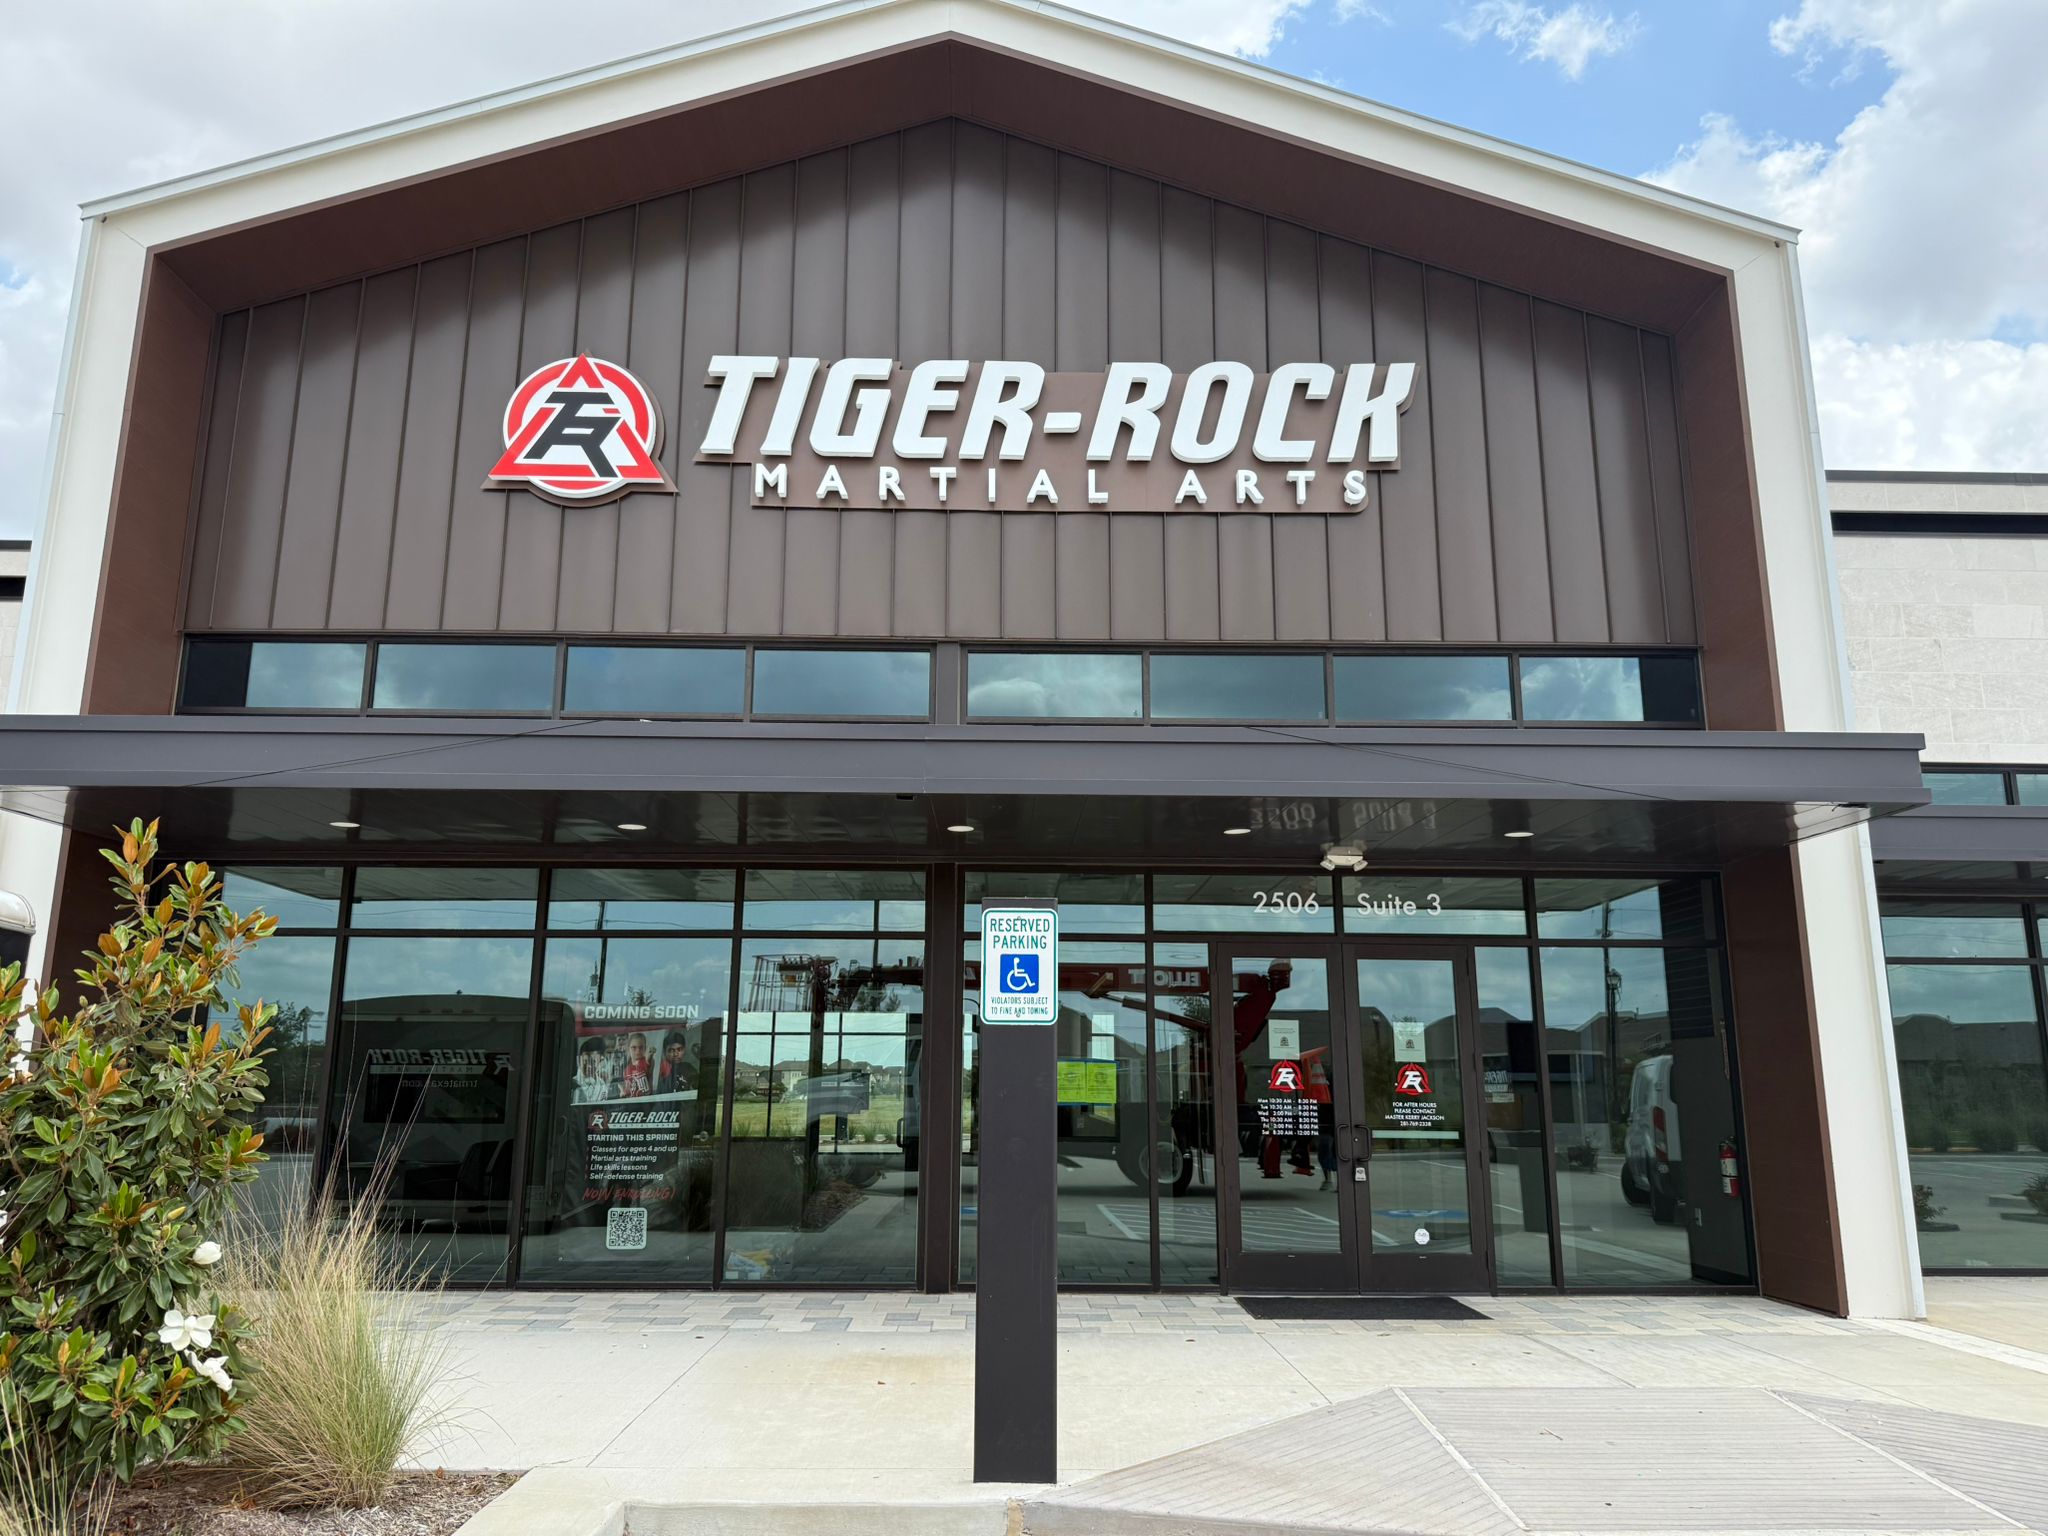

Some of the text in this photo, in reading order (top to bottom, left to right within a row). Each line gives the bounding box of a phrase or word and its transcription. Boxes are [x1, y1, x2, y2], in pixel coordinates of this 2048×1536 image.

[699, 354, 1416, 463] TIGER-ROCK
[754, 462, 1367, 505] MARTIAL ARTS
[1253, 891, 1319, 914] 2506
[1357, 893, 1441, 916] Suite 3
[990, 918, 1050, 932] RESERVED
[993, 935, 1047, 949] PARKING
[991, 996, 1048, 1005] VIOLATORS SUBJECT
[584, 1004, 699, 1019] COMING SOON
[991, 1007, 1048, 1015] TO FINE AND TOWING
[609, 1111, 680, 1123] TIGER-ROCK
[645, 1133, 677, 1141] SPRING!
[591, 1145, 616, 1153] Classes
[618, 1145, 628, 1153] for
[590, 1154, 614, 1162] Martial
[630, 1154, 657, 1162] training
[636, 1173, 664, 1181] training
